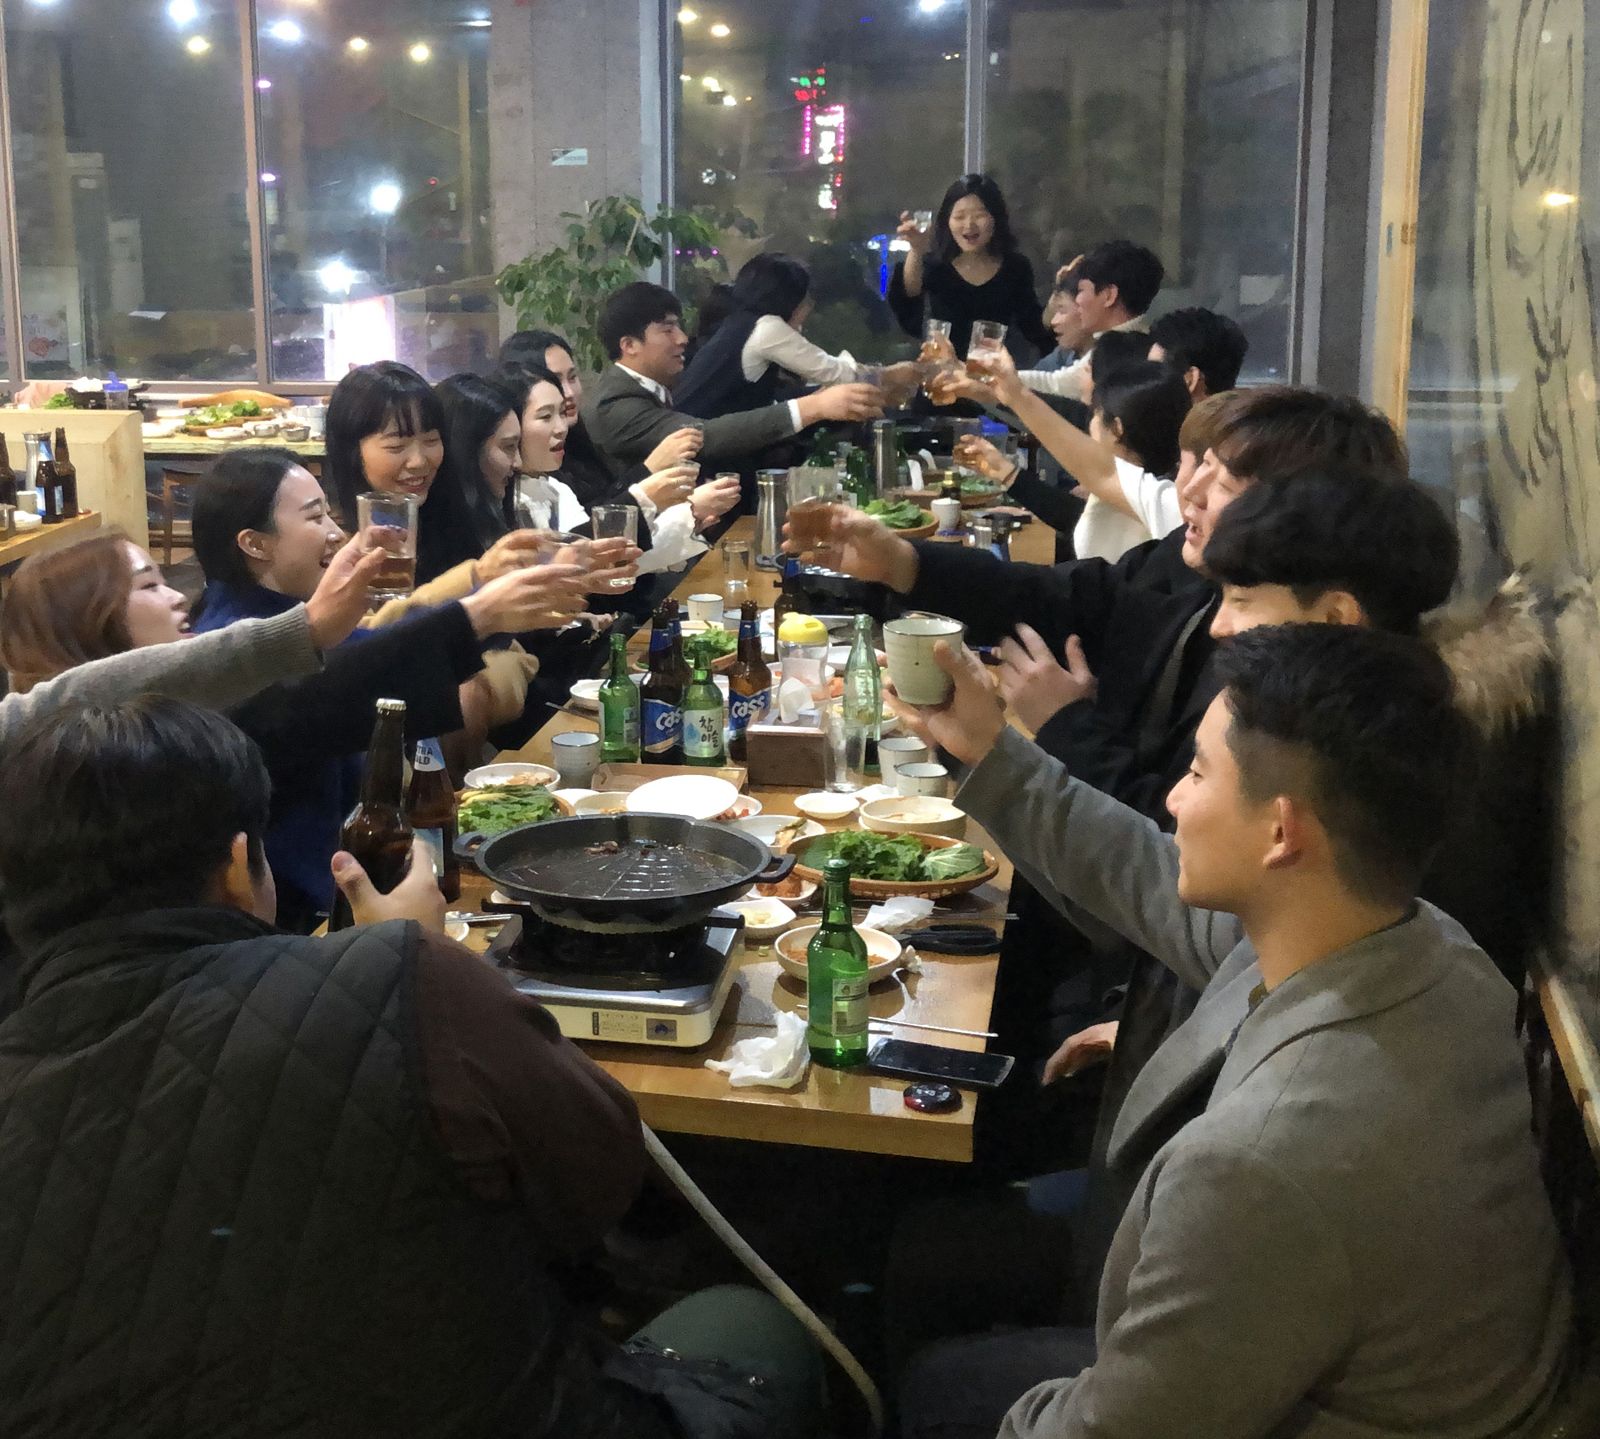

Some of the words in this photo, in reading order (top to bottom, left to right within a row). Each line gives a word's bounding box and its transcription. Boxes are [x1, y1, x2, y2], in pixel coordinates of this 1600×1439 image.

[656, 707, 683, 730] Cas
[699, 716, 715, 733] 참
[701, 730, 719, 748] 이슬
